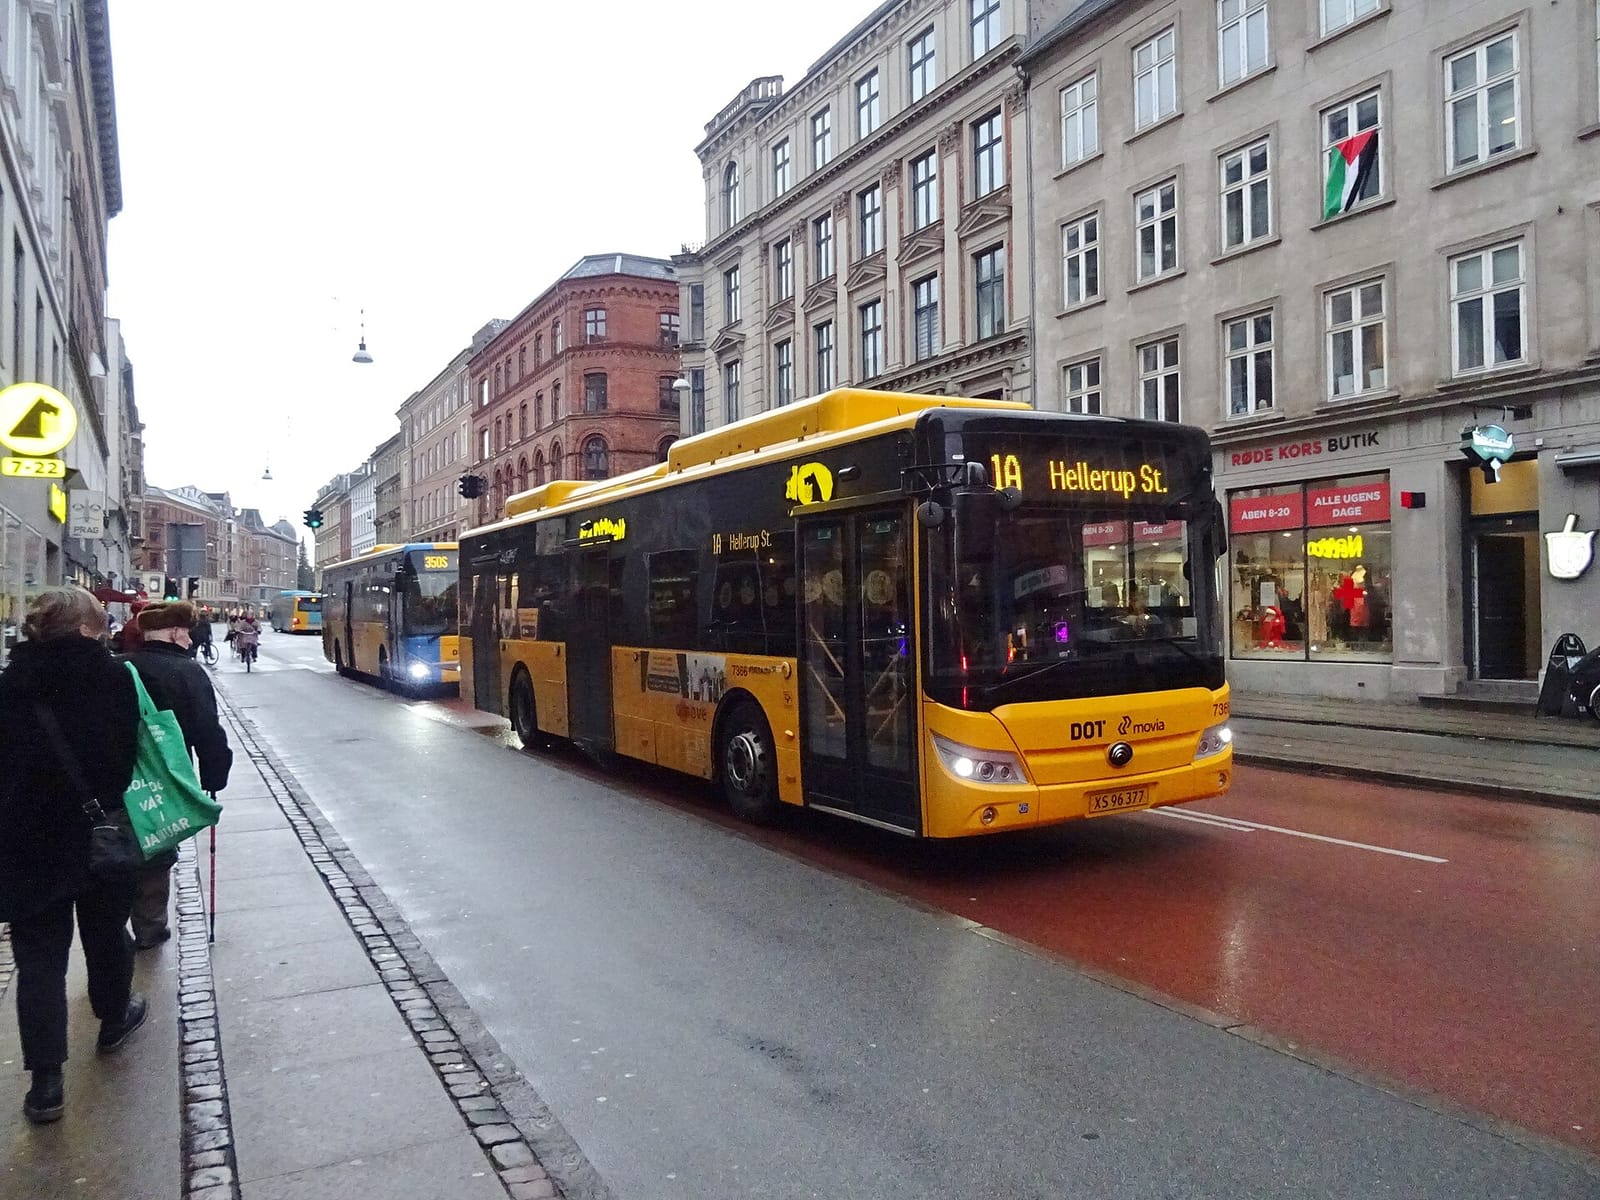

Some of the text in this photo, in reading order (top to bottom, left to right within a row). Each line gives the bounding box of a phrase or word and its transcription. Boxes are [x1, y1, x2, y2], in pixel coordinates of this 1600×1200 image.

[1231, 431, 1380, 467] RØDE KORS BUTIK
[11, 461, 58, 474] 7-22
[991, 454, 1168, 499] 1A Hellerup St.
[1314, 491, 1381, 507] ALLE UGENS
[1332, 507, 1362, 518] DAGE
[73, 526, 100, 534] PRAG
[712, 533, 722, 555] 1A
[729, 532, 760, 553] Hellerup
[1212, 702, 1230, 717] 736
[1070, 719, 1165, 740] DOT movia
[1094, 790, 1145, 810] XS 96 377
[143, 817, 190, 849] JANUAR
